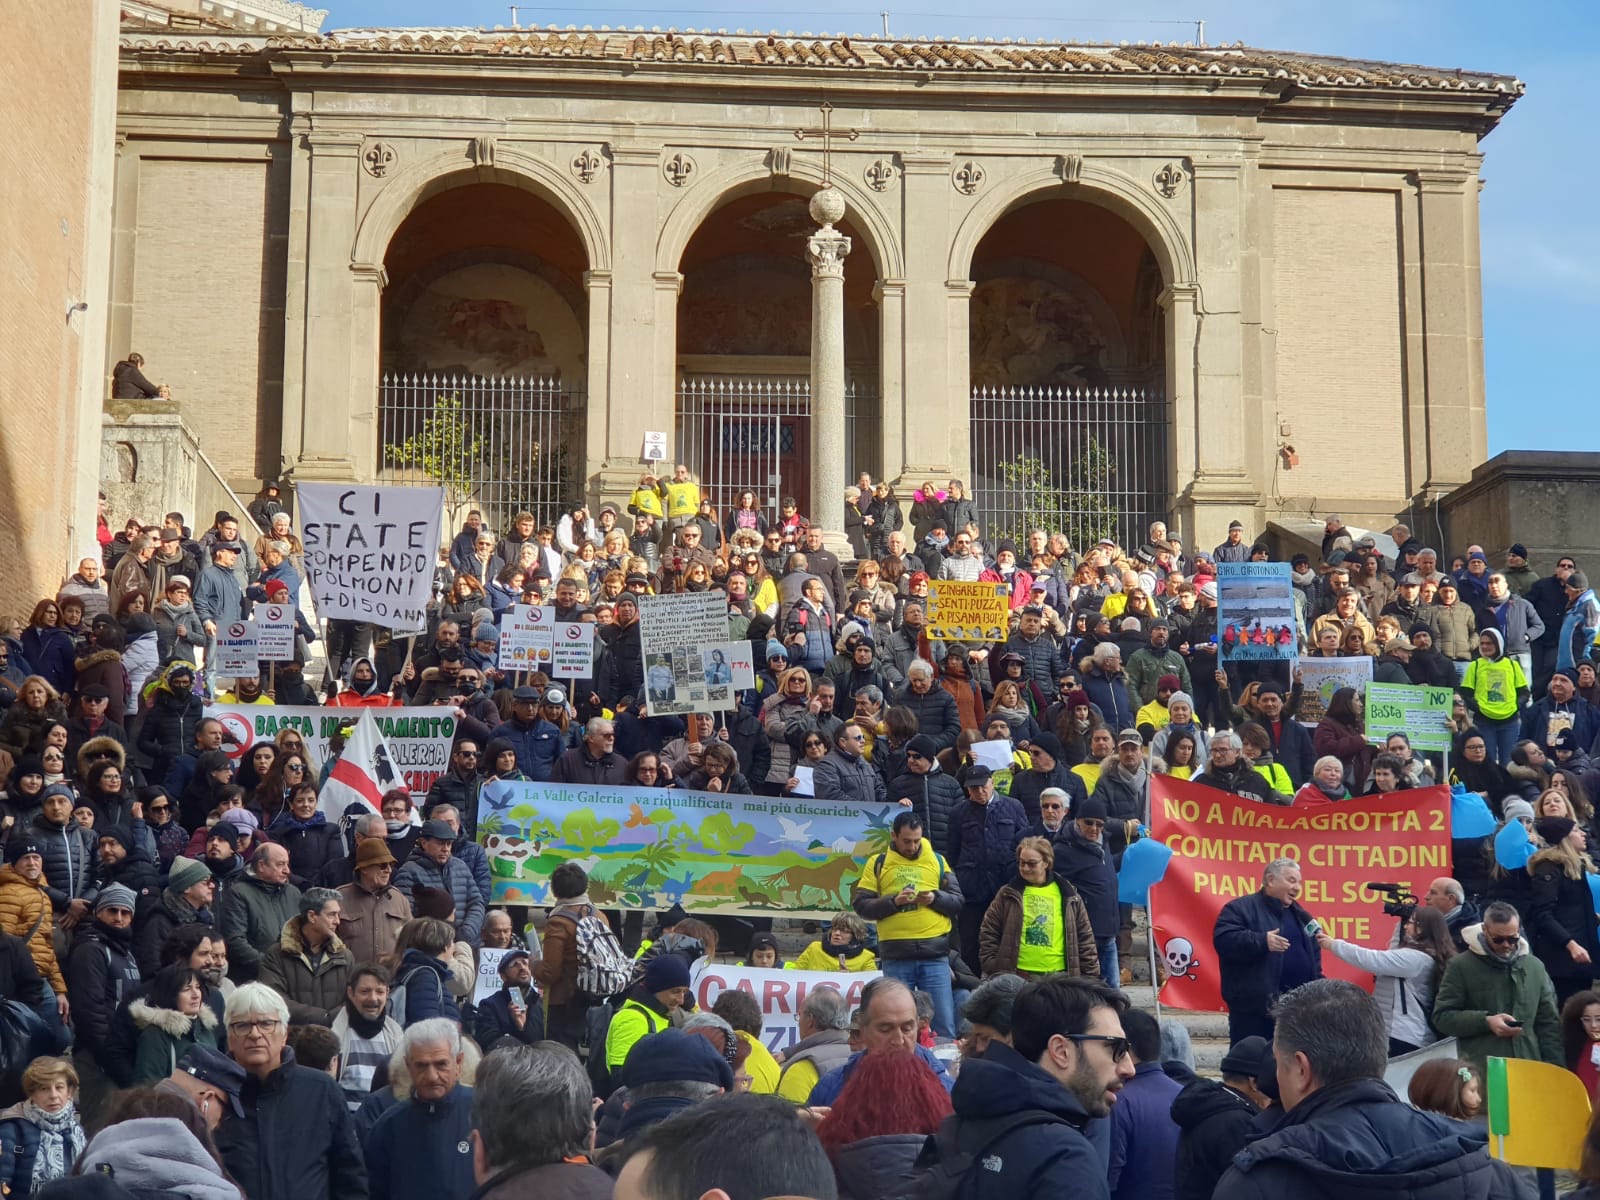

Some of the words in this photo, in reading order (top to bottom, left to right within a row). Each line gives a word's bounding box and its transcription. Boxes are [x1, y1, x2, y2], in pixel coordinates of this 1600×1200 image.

[338, 490, 380, 516] CI
[304, 521, 428, 549] STATE
[314, 568, 414, 596] POLMONI
[938, 584, 994, 598] ZINGARETTI
[392, 608, 425, 622] ANN
[937, 611, 944, 620] A
[946, 611, 981, 624] PISANA
[731, 662, 750, 670] TTA
[254, 714, 314, 738] BASTA
[524, 788, 540, 800] La
[544, 790, 574, 802] Valle
[577, 791, 624, 804] Galeria
[635, 796, 650, 806] va
[653, 794, 733, 810] riqualificata
[744, 800, 767, 812] mai
[770, 802, 790, 816] più
[794, 802, 860, 818] discariche
[1164, 798, 1200, 823] NO
[1206, 802, 1224, 824] A
[1232, 806, 1422, 832] MALAGROTTA
[1428, 810, 1446, 831] 2
[1166, 834, 1300, 864] COMITATO
[1308, 845, 1448, 868] CITTADINI
[1320, 916, 1370, 940] NTE
[480, 964, 496, 974] Ga
[485, 976, 503, 988] Lib
